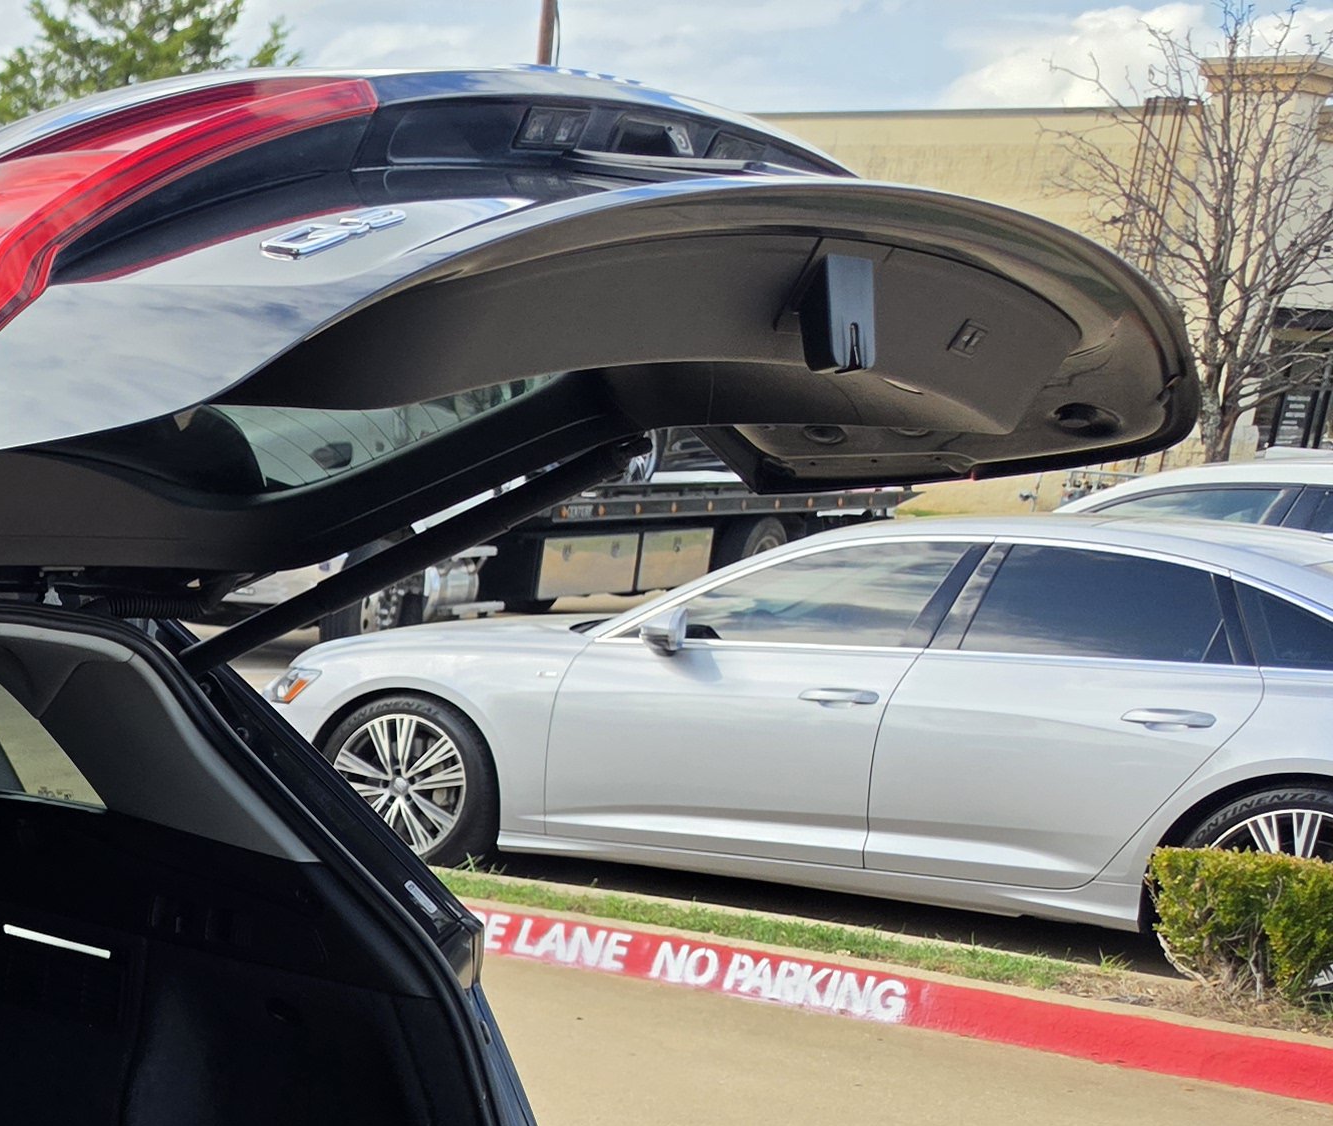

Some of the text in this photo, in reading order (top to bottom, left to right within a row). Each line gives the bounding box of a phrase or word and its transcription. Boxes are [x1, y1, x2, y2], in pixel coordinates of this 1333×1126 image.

[513, 918, 633, 971] LANE
[649, 941, 719, 984] NO
[722, 953, 908, 1022] PARKING
